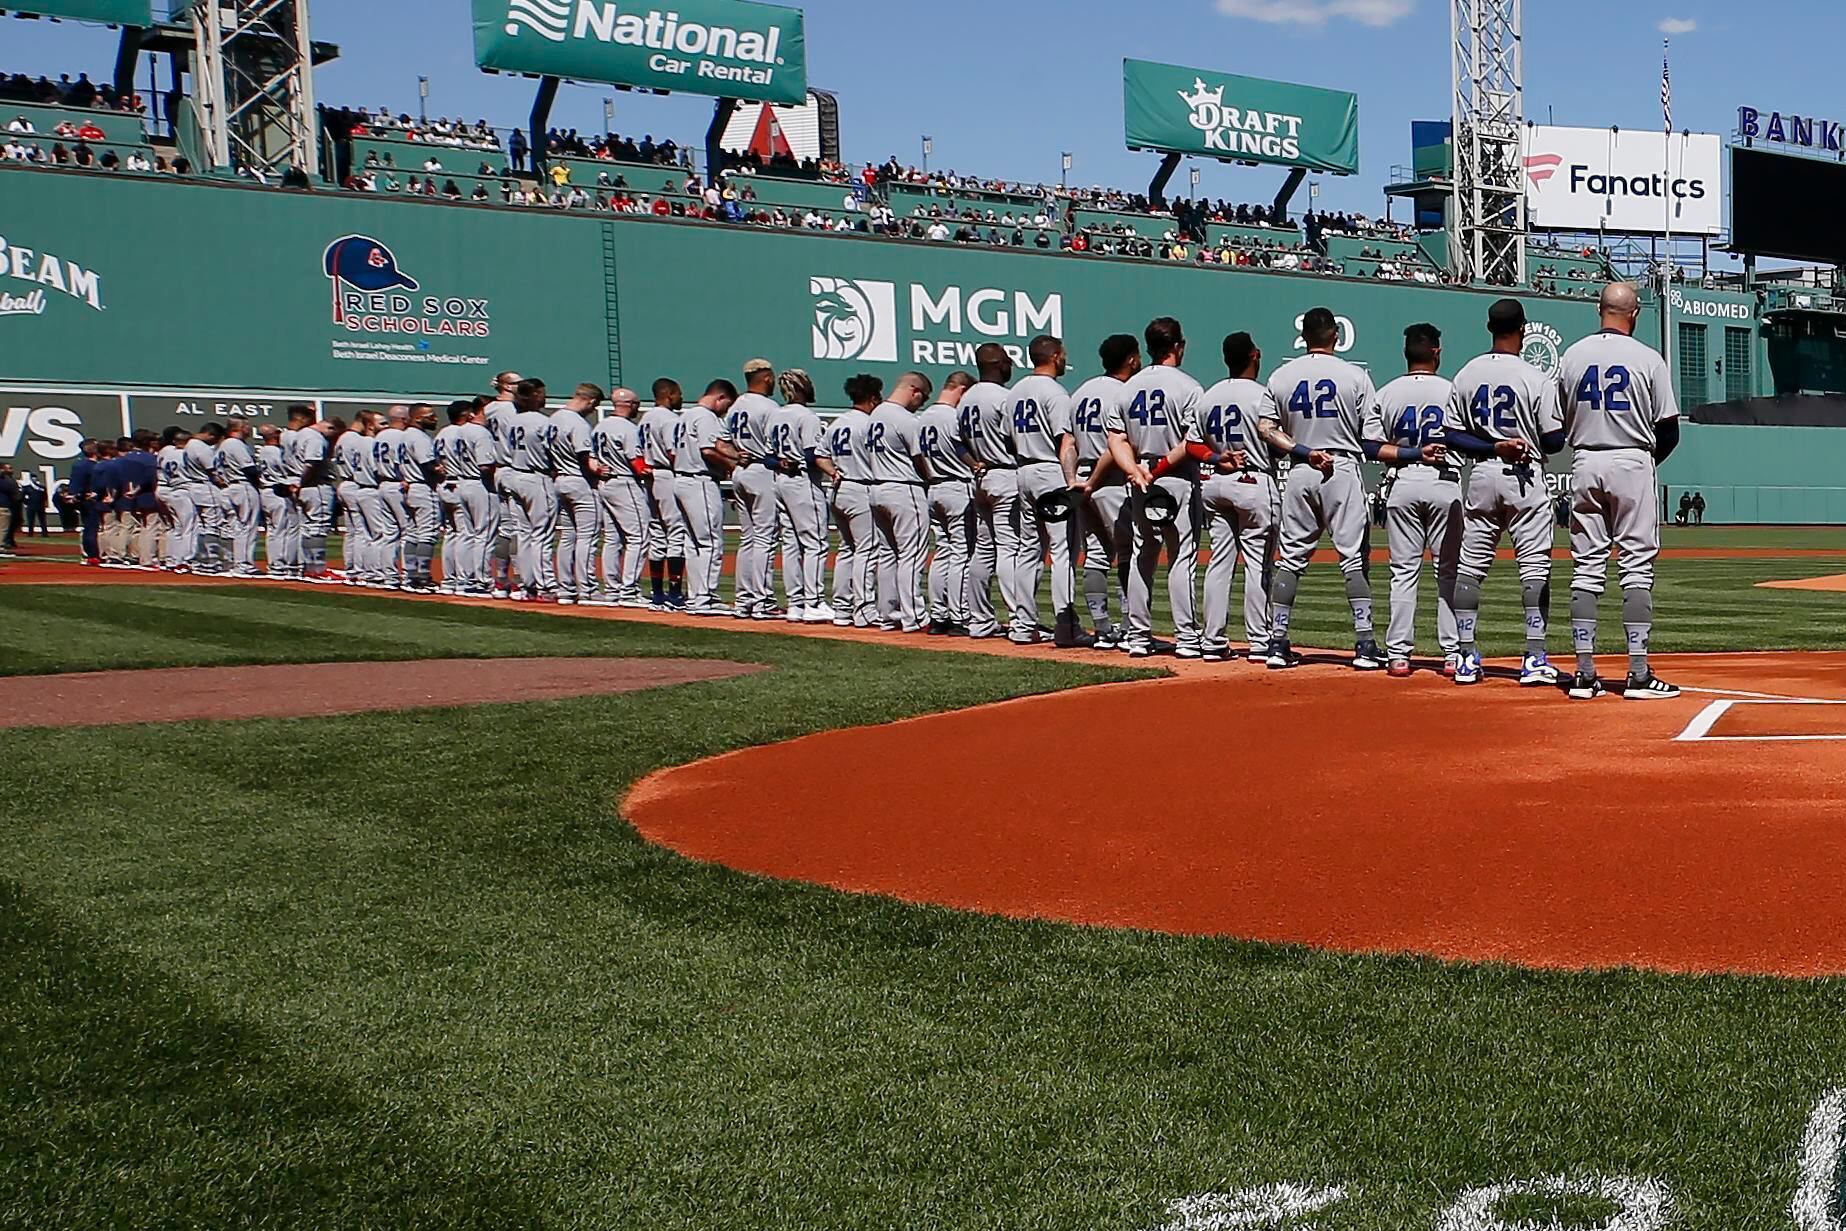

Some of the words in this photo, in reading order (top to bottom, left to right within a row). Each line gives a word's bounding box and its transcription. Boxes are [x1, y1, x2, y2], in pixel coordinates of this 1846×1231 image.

[573, 0, 777, 64] National
[649, 53, 691, 75] Car
[697, 59, 773, 86] Rental
[1188, 102, 1303, 137] DRAFT
[1737, 105, 1841, 152] BANK
[1204, 127, 1301, 160] KINGS
[1570, 164, 1706, 199] Fanatics
[345, 292, 411, 314] RED
[423, 296, 489, 318] SOX
[910, 283, 1063, 339] MGM
[1683, 302, 1749, 319] ABIOMED
[345, 313, 489, 337] SCHOLARS
[333, 350, 355, 359] Beth
[355, 351, 379, 360] Israel
[426, 354, 460, 363] Medical
[461, 356, 489, 365] Center
[912, 340, 1074, 370] REWR
[1288, 378, 1338, 419] 42
[1576, 364, 1631, 411] 42
[176, 402, 204, 416] AL
[215, 402, 273, 417] EAST
[961, 405, 983, 438] 42
[1013, 398, 1040, 433] 42
[1076, 397, 1101, 433] 42
[1128, 388, 1166, 426] 42
[1470, 384, 1518, 428] 42
[509, 426, 526, 451] 42
[730, 411, 751, 440] 42
[772, 423, 792, 452] 42
[865, 422, 885, 453] 42
[1206, 403, 1244, 442] 42
[1395, 405, 1445, 446] 42
[373, 441, 390, 464] 42
[832, 426, 852, 456] 42
[919, 425, 938, 457] 42
[1275, 613, 1289, 626] 42
[1458, 617, 1474, 631] 42
[1526, 616, 1542, 628] 42
[1573, 628, 1589, 641] 42
